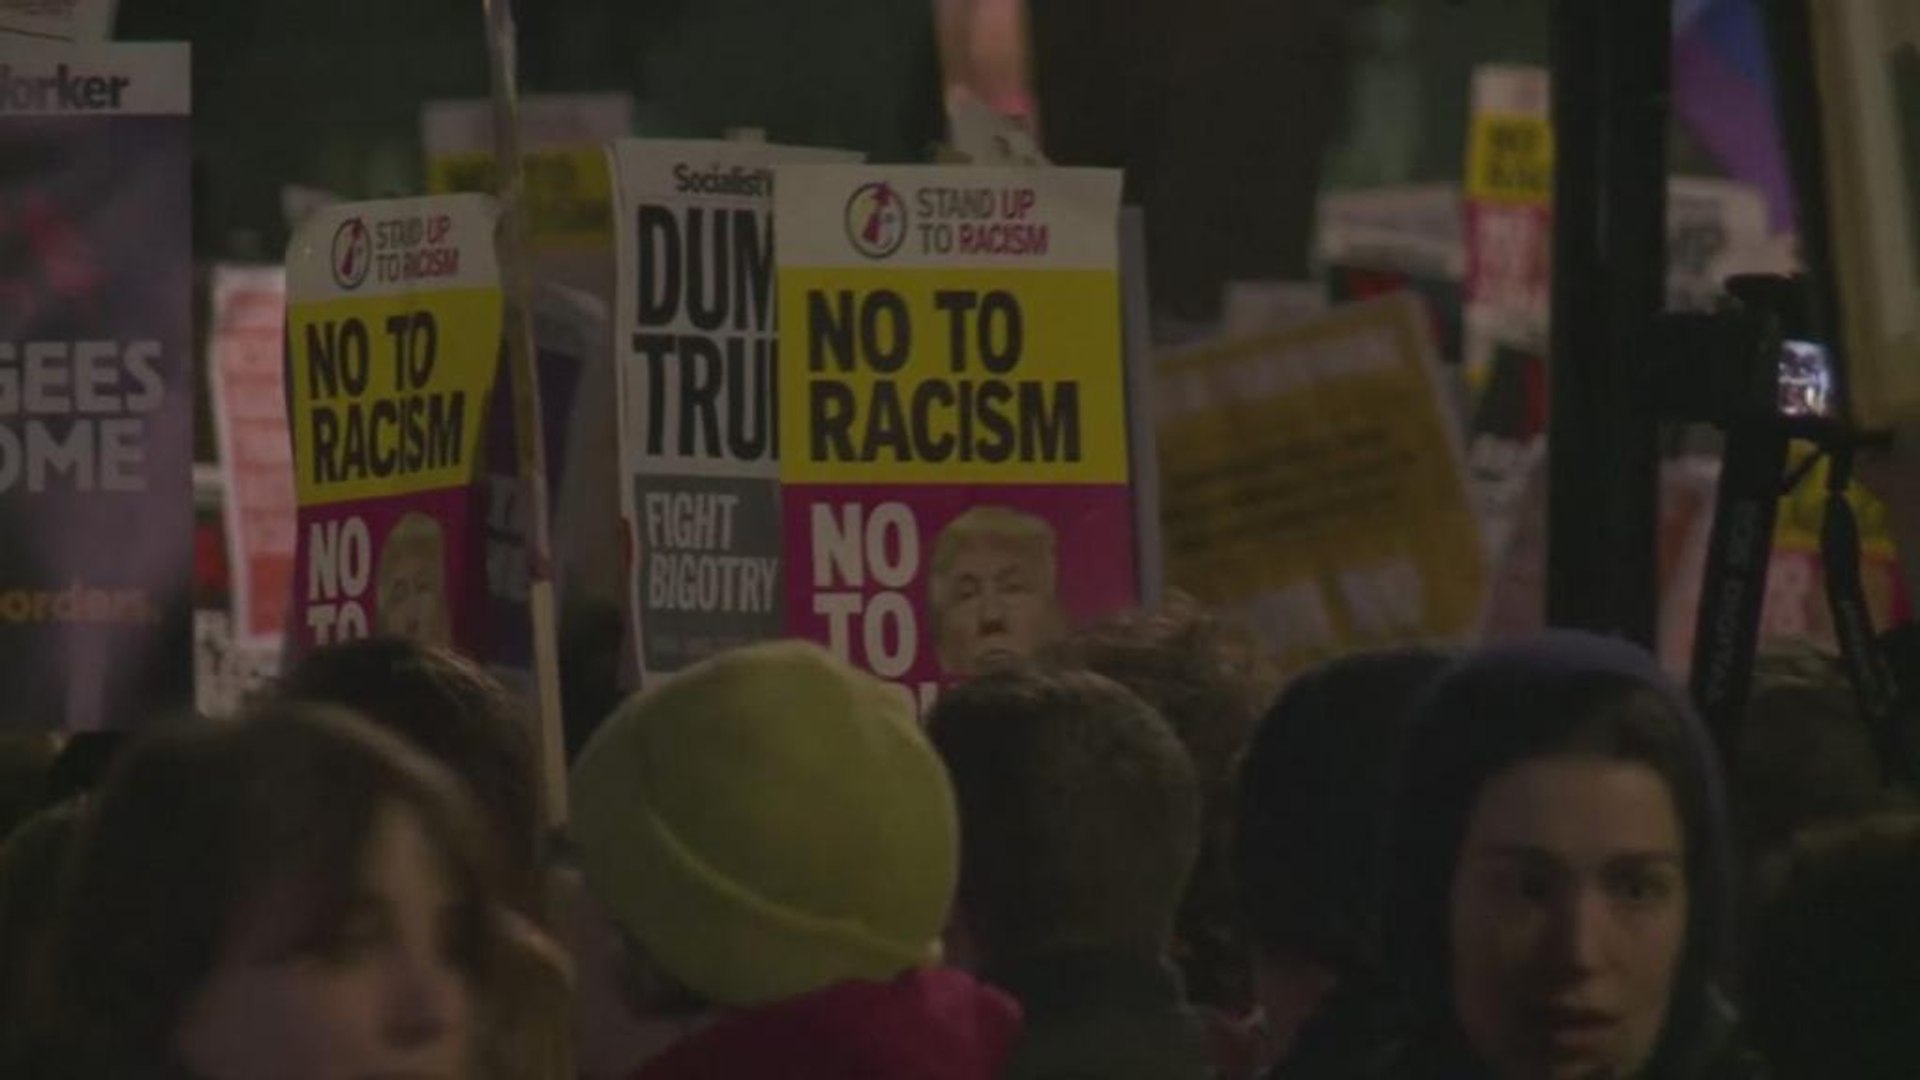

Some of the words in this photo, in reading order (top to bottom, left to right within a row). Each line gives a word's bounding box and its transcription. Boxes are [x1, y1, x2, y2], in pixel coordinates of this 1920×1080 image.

[0, 63, 129, 109] orker
[427, 213, 451, 244] UP
[916, 187, 994, 219] STAND
[1001, 188, 1036, 219] UP
[918, 224, 952, 255] TO
[958, 223, 1048, 256] RACISM
[376, 253, 401, 282] TO
[306, 318, 369, 400] NO
[386, 311, 438, 392] TO
[807, 290, 912, 373] NO
[934, 290, 1023, 373] TO
[311, 391, 465, 484] RACISM
[633, 333, 779, 461] TRU
[810, 379, 1081, 462] RACISM
[309, 516, 372, 601] NO
[645, 492, 739, 551] FIGHT
[811, 502, 920, 588] NO
[650, 551, 778, 613] BIGOTRY
[813, 590, 917, 679] TO
